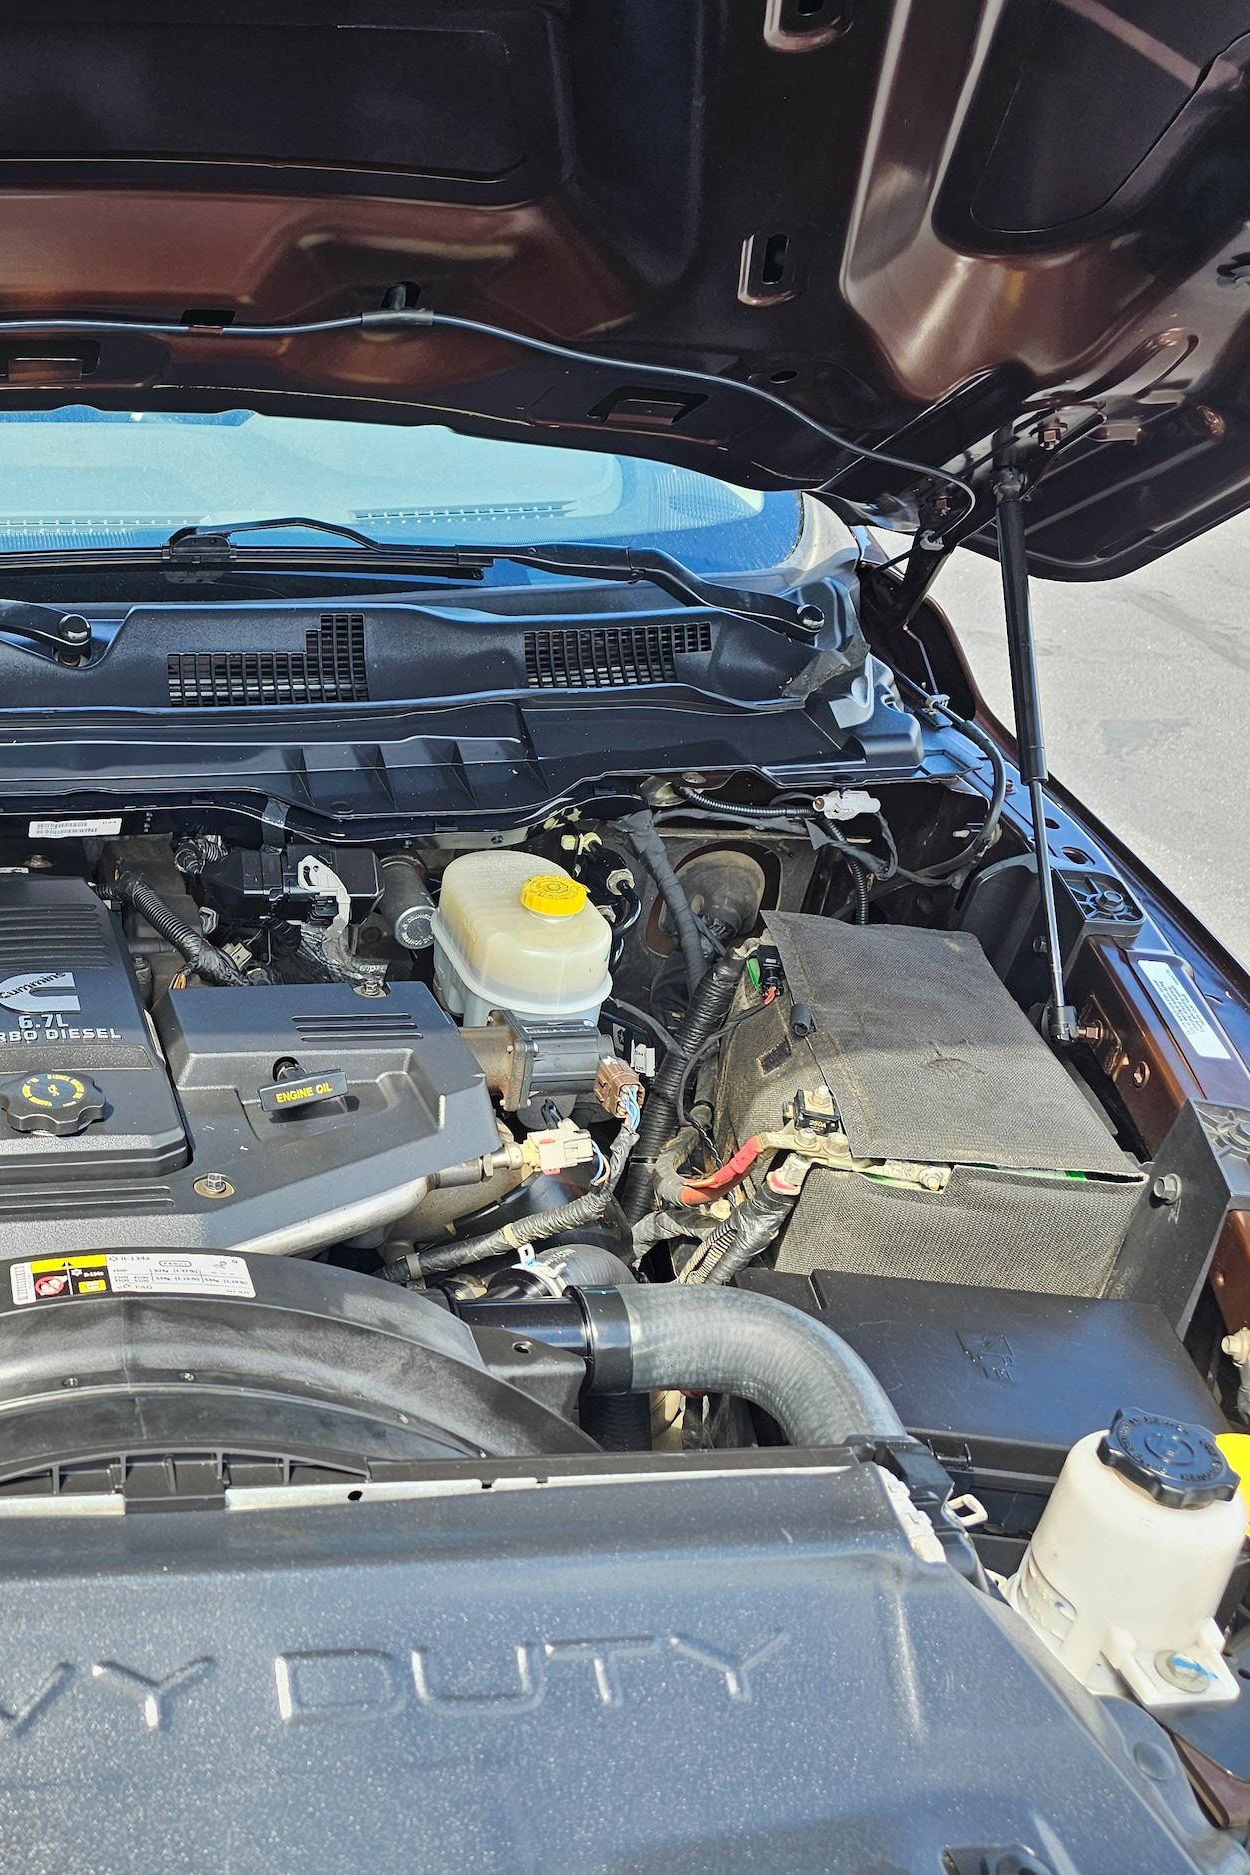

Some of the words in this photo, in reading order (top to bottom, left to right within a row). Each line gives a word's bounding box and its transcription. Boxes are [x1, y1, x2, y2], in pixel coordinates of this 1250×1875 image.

[18, 1013, 69, 1030] 6.7L
[46, 1027, 123, 1041] DIESEL
[275, 1086, 314, 1103] ENGINE
[315, 1082, 333, 1095] OIL
[273, 1628, 792, 1727] DUTY
